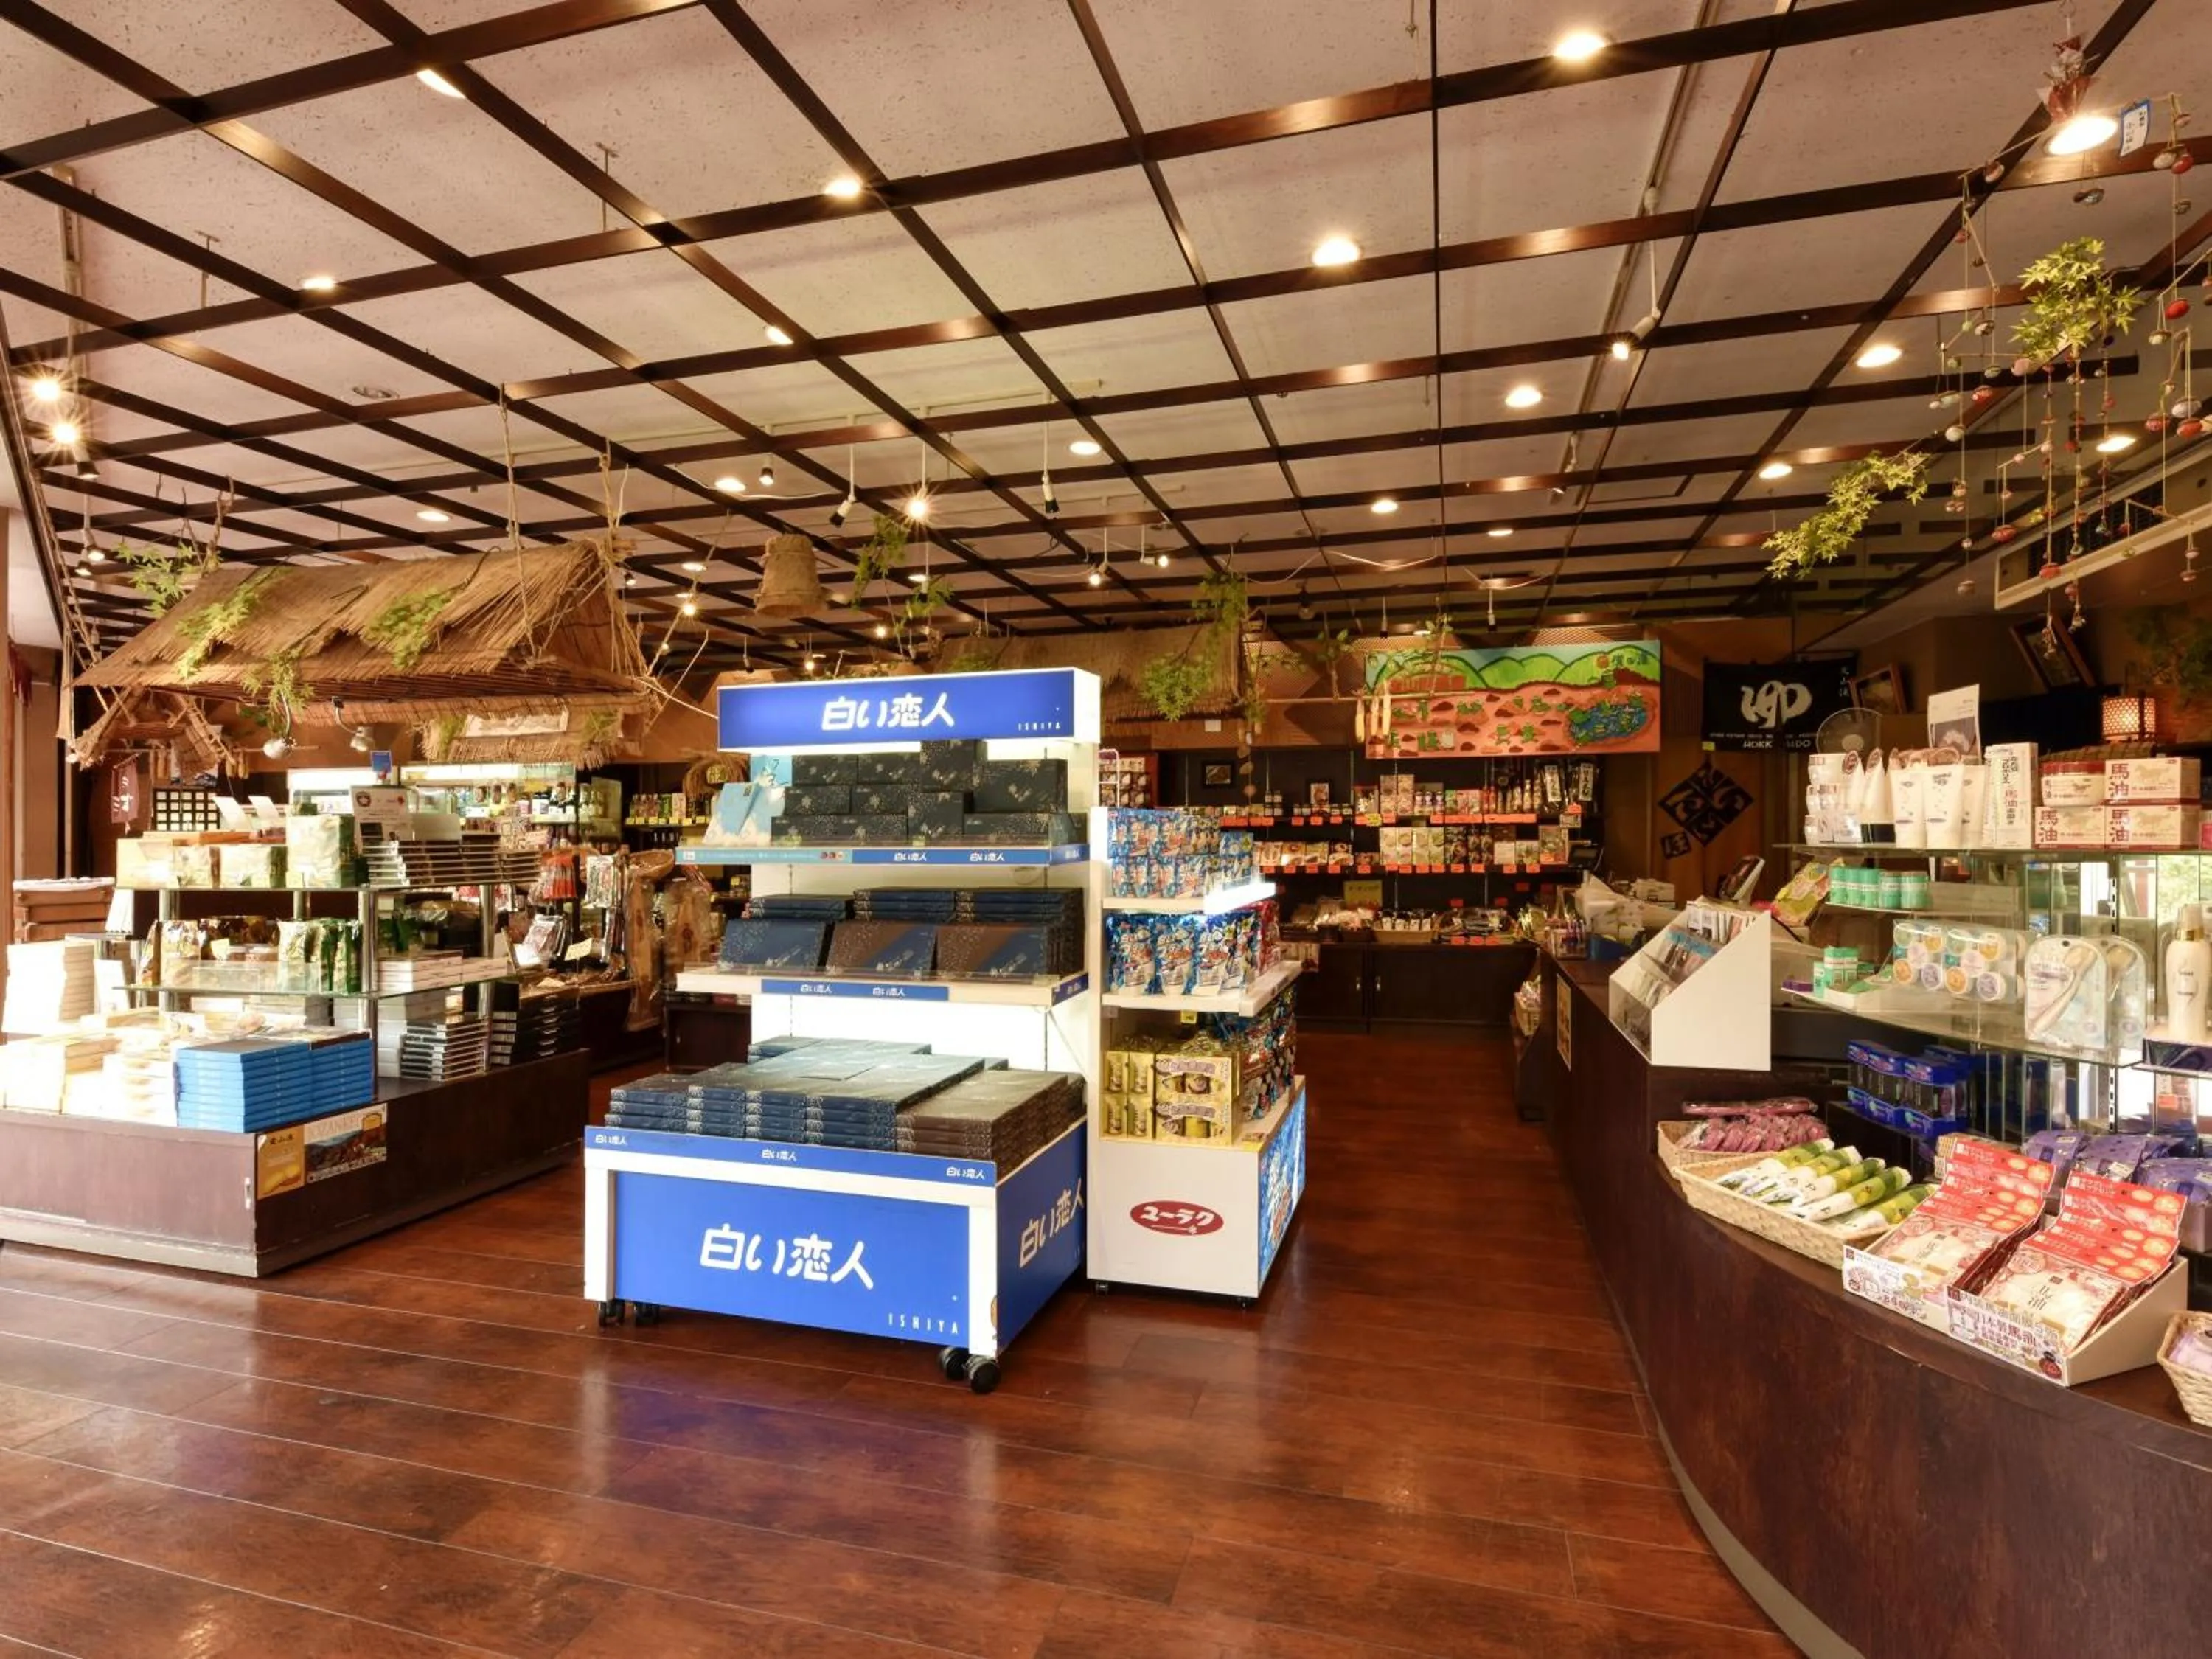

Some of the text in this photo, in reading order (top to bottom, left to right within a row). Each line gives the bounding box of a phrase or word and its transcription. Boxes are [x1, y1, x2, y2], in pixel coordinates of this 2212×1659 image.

[821, 692, 955, 731] 白い恋人
[1018, 721, 1061, 731] ISHIYA
[2109, 763, 2130, 799] 馬油
[2039, 810, 2058, 842] 馬油
[2109, 809, 2130, 842] 馬油
[894, 851, 927, 862] 白い恋人
[970, 851, 1005, 862] 白い恋人
[800, 983, 832, 994] 白い恋人
[872, 986, 906, 997] 白い恋人
[595, 1134, 628, 1146] 白い恋人
[761, 1149, 797, 1162] 白い恋人
[946, 1166, 985, 1180] 白い恋人
[1020, 1178, 1084, 1269] 白い恋人
[1139, 1206, 1215, 1226] ユーラク
[699, 1223, 874, 1290] 白い恋人
[888, 1312, 959, 1335] ISHIYA
